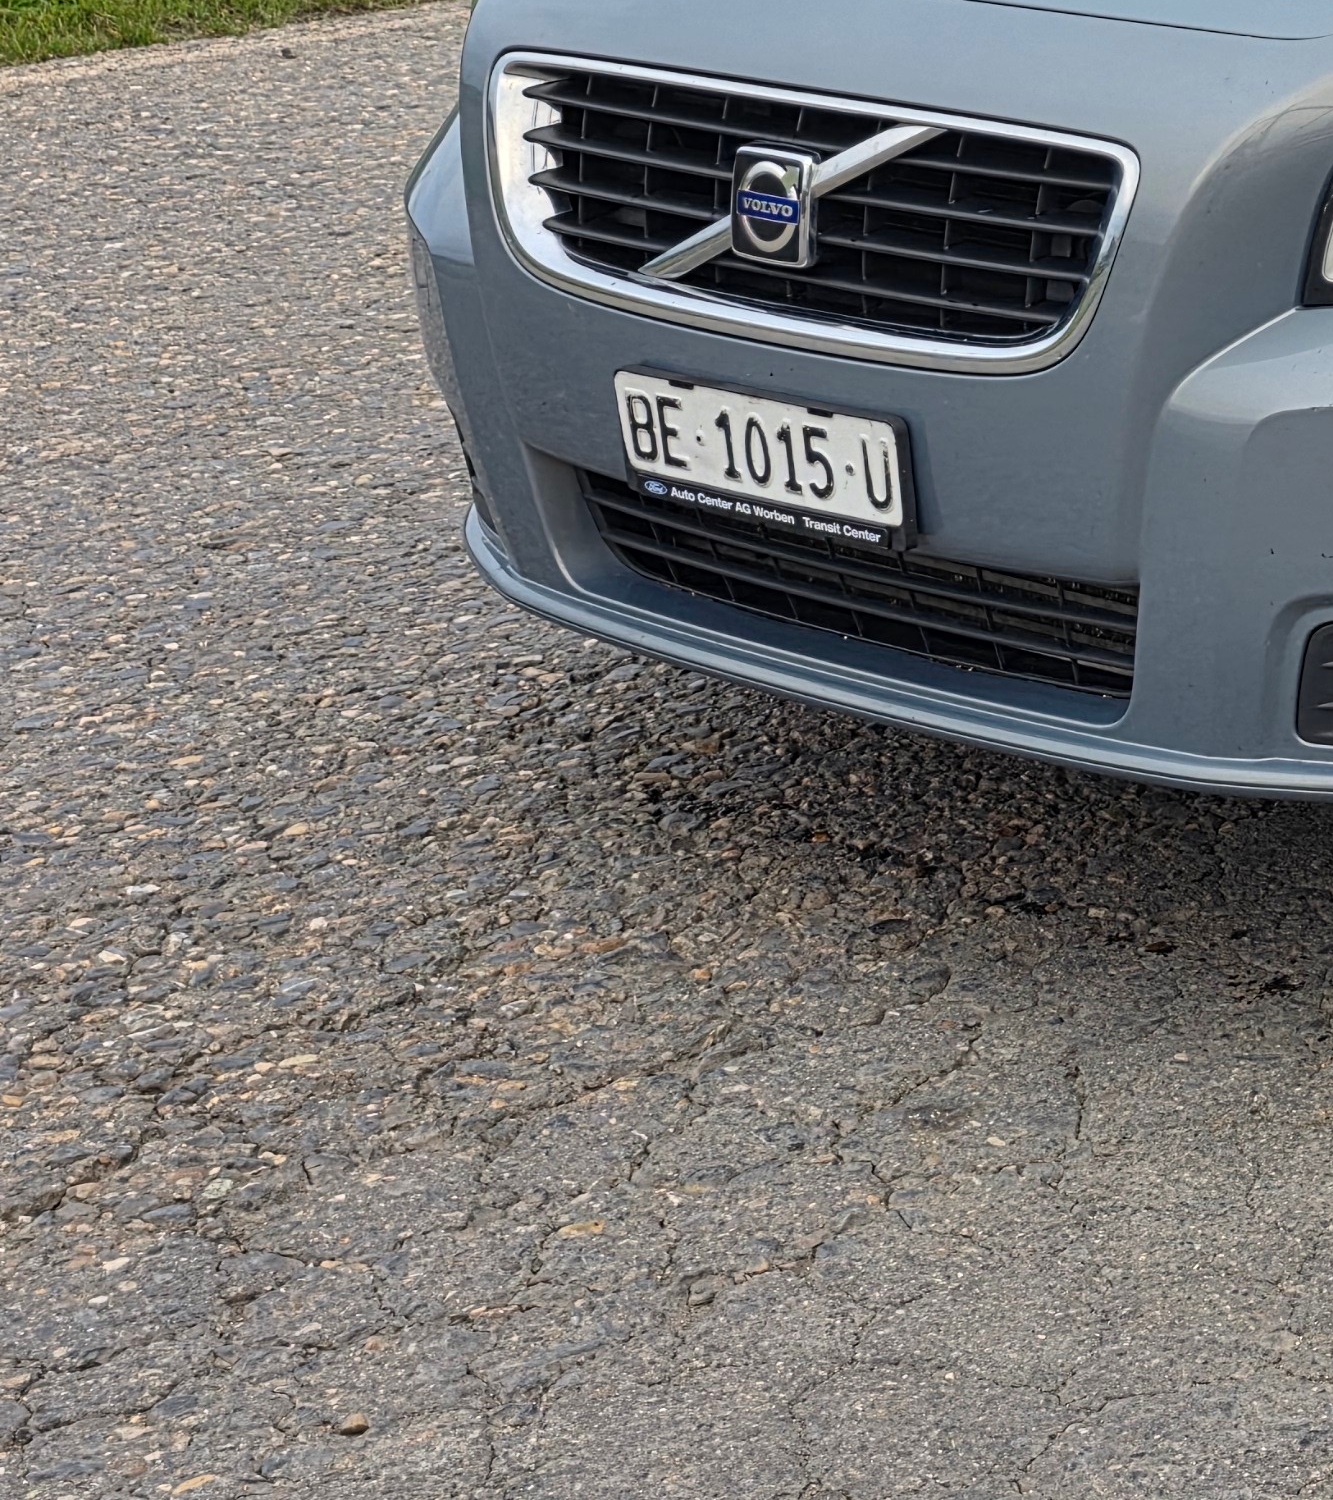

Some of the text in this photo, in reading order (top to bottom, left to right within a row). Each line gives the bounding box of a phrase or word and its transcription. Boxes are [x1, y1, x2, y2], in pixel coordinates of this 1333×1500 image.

[742, 197, 794, 218] VOLVO
[670, 486, 696, 502] Auto
[697, 493, 734, 510] Center
[735, 501, 752, 514] AG
[753, 505, 795, 525] Worben
[802, 516, 841, 535] Transit
[843, 524, 882, 543] Center
